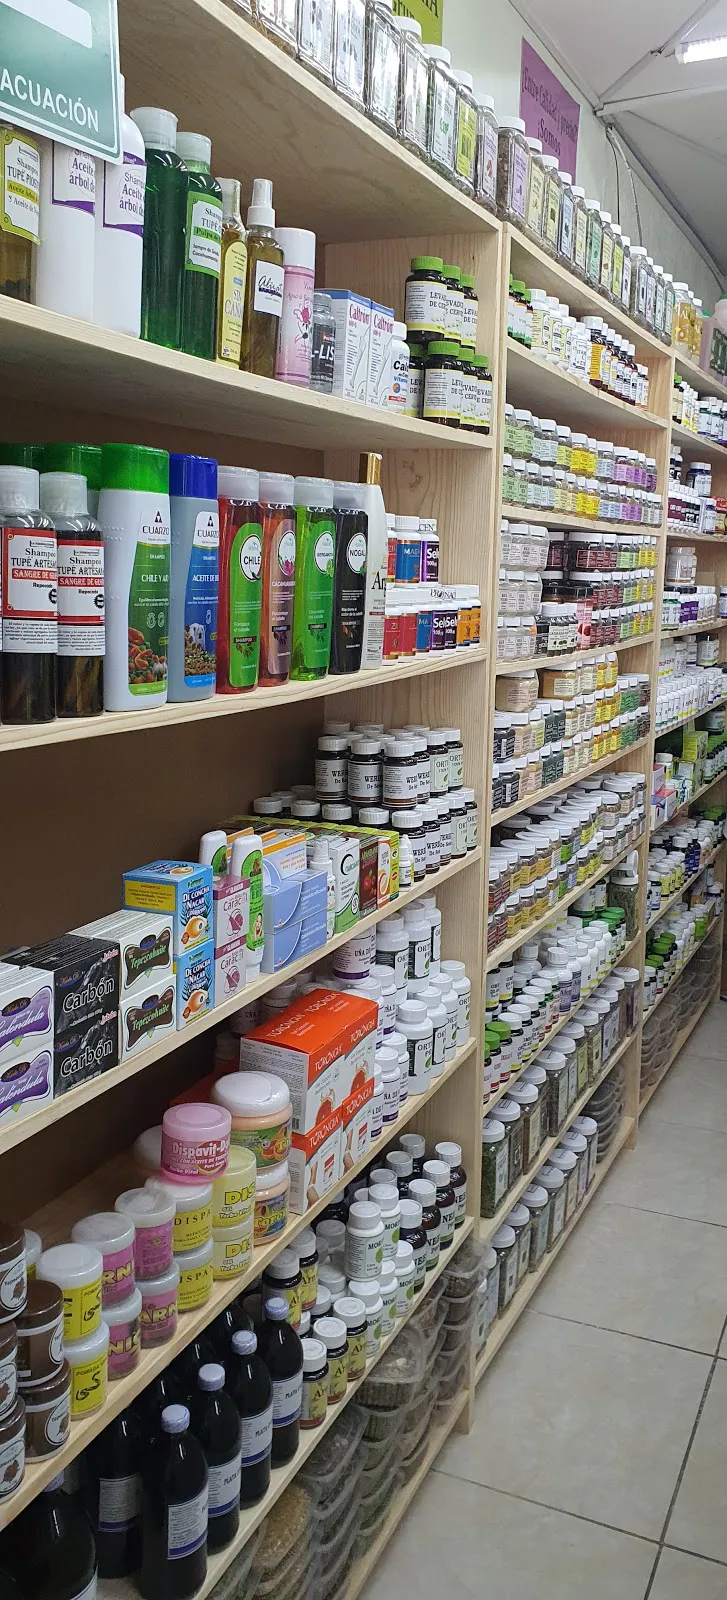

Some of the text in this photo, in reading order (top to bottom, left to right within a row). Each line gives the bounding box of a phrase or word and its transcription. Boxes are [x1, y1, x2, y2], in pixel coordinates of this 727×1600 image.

[142, 526, 169, 536] CUARZO
[11, 557, 31, 567] TUPÉ
[243, 556, 261, 566] CHILE
[14, 569, 49, 579] SANGRE DE
[141, 574, 158, 582] CHILE
[60, 577, 86, 585] SANGRE
[62, 977, 115, 1013] Carbón
[60, 1039, 113, 1078] Carbón
